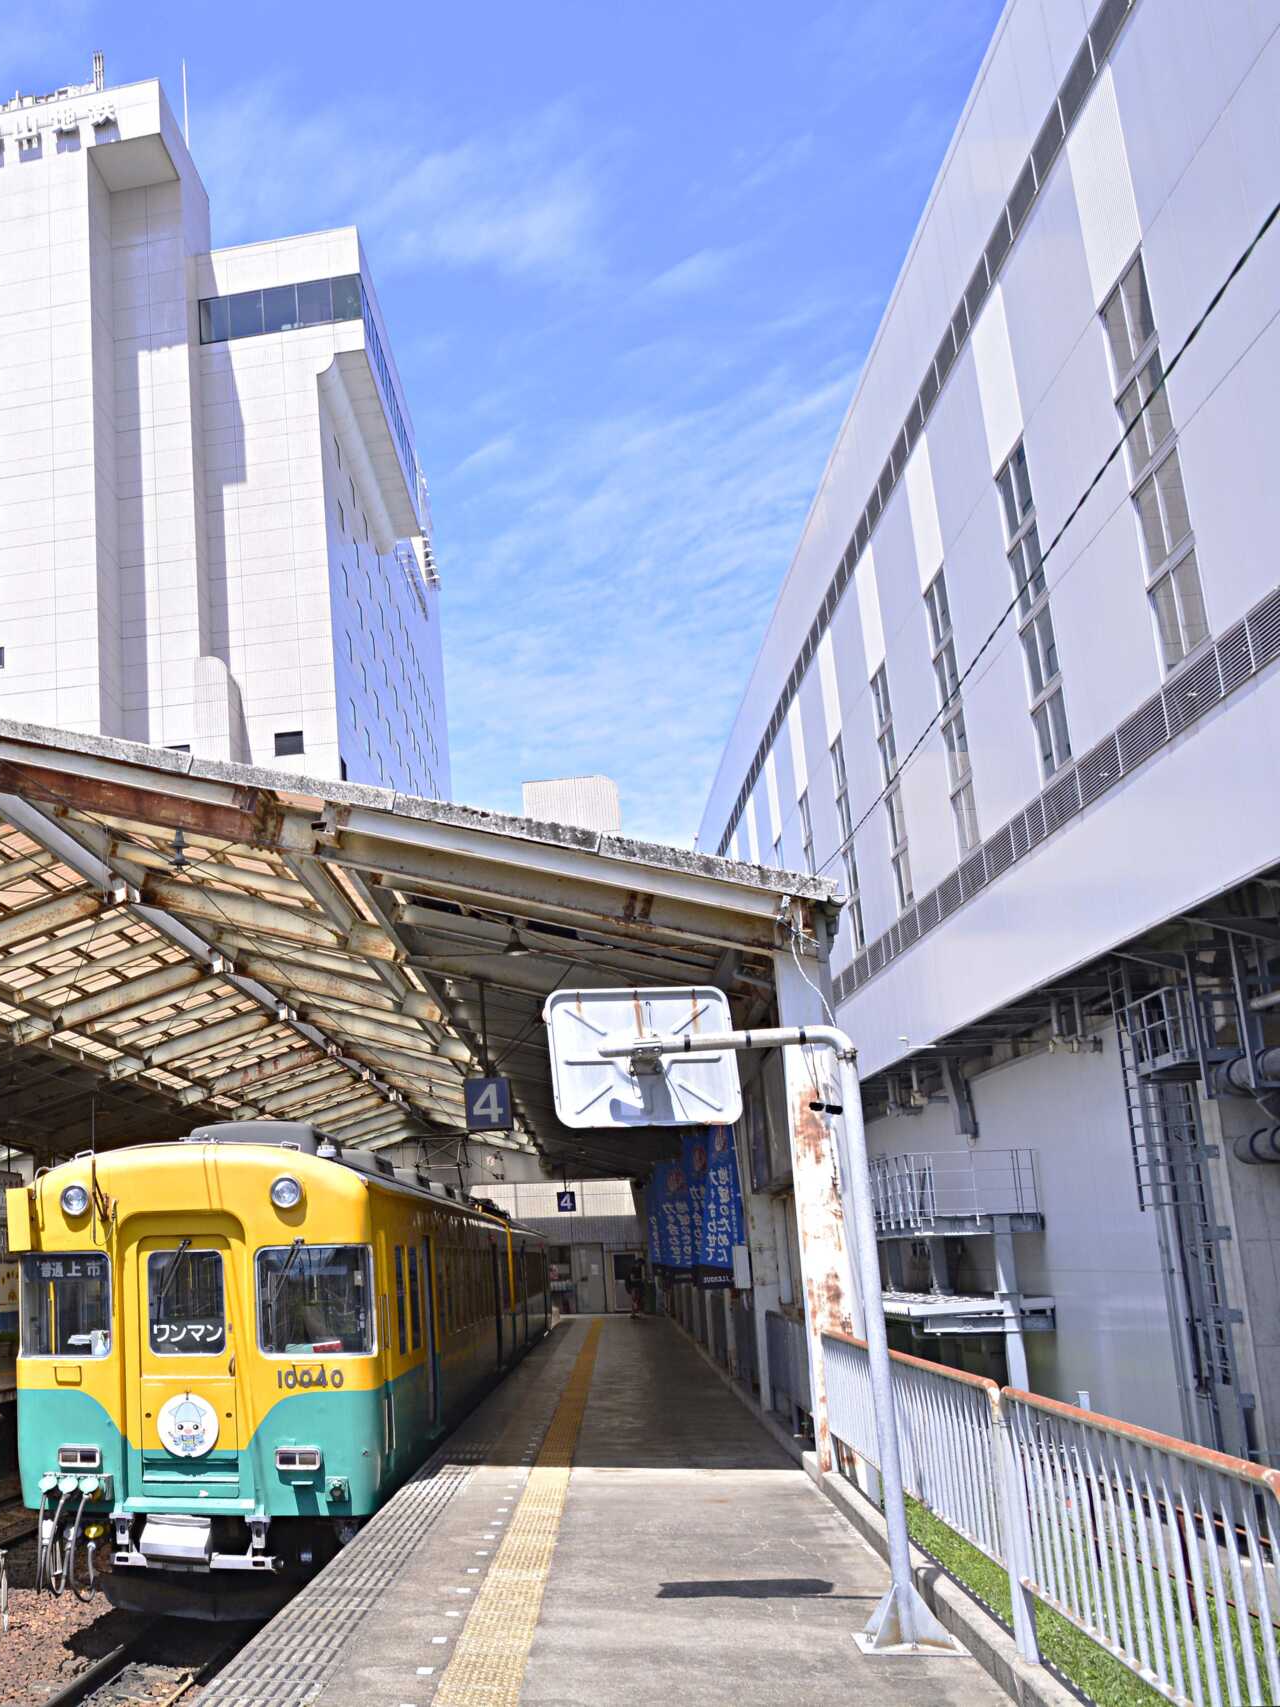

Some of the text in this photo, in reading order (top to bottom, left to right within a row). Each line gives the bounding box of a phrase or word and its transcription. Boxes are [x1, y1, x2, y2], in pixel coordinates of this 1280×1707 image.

[472, 1083, 504, 1123] 4
[560, 1193, 573, 1210] 4
[153, 1324, 223, 1343] ワンマン
[277, 1368, 345, 1389] 10040
